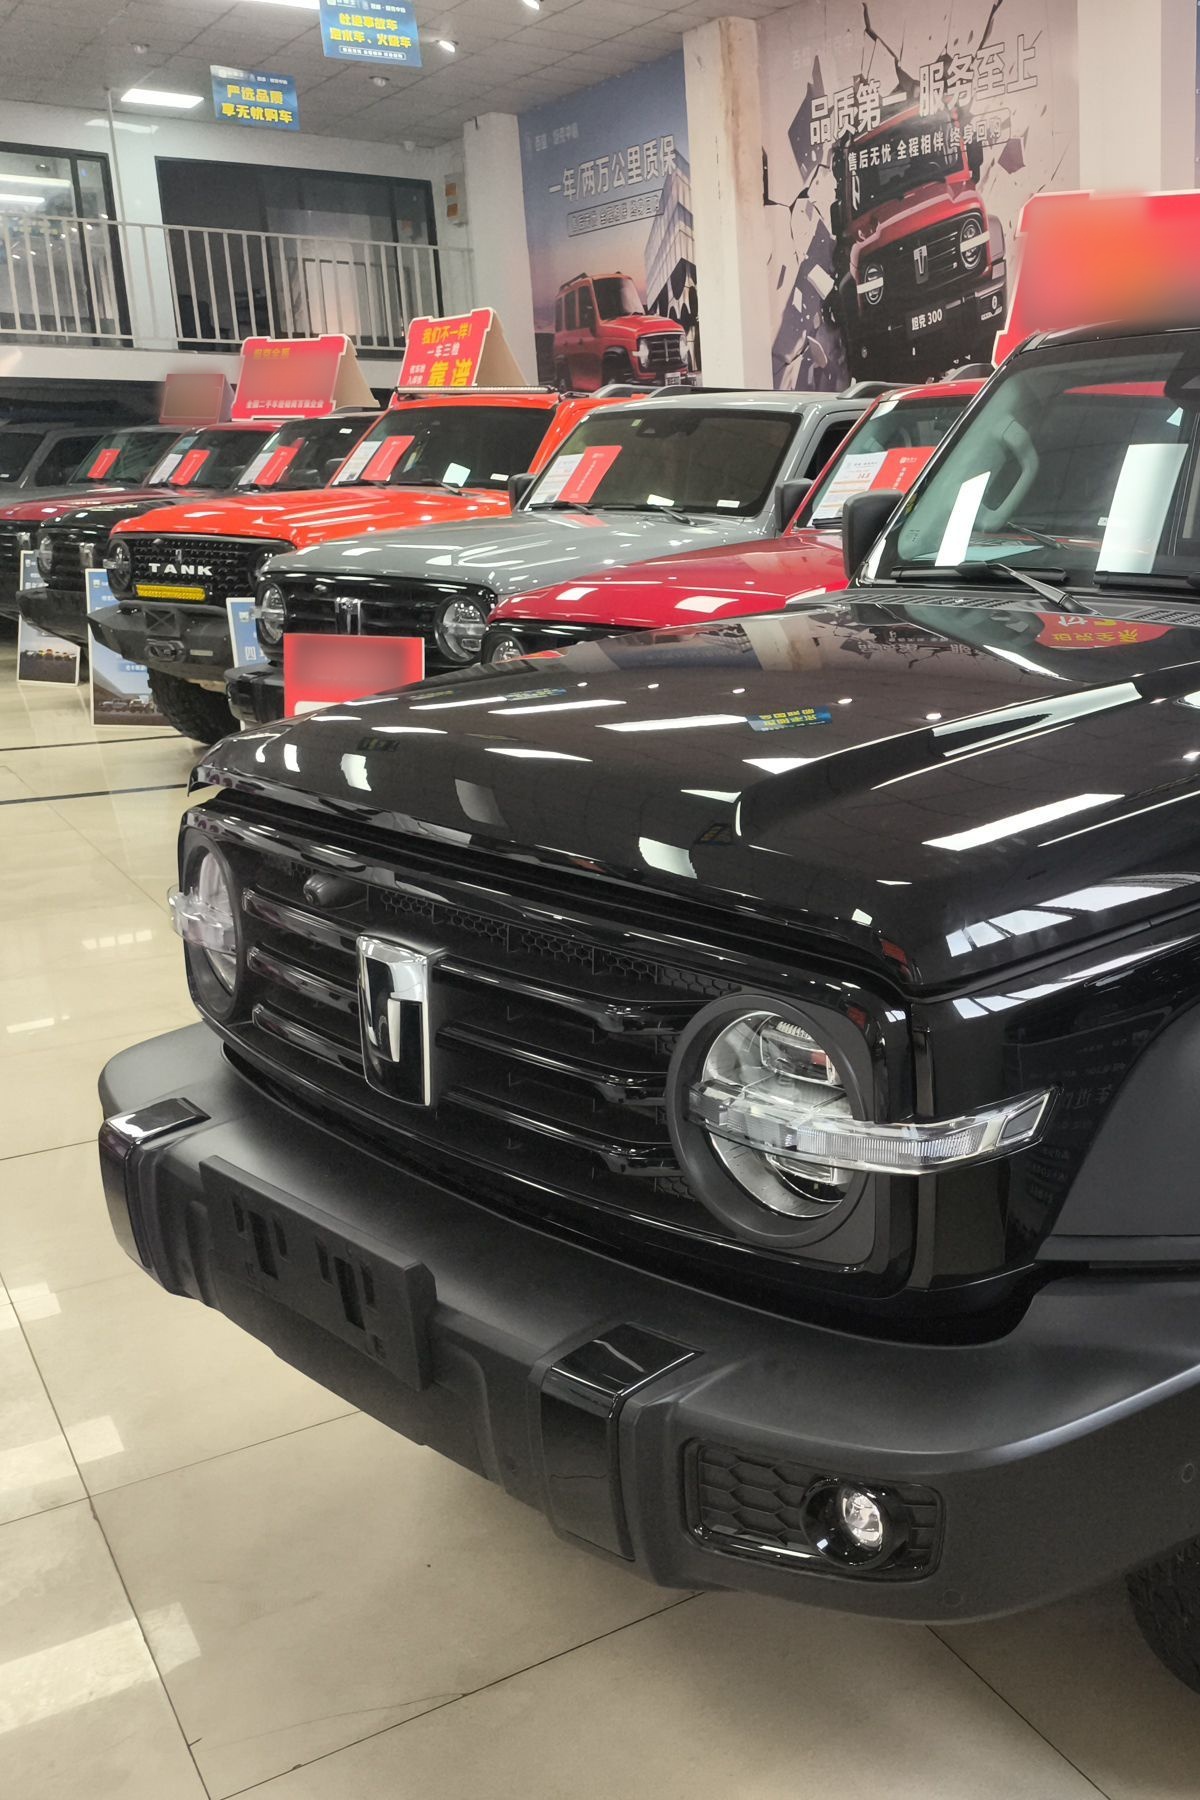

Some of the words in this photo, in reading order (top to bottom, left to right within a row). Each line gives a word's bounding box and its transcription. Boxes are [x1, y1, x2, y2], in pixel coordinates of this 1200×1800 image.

[227, 84, 283, 104] 严选品质
[810, 78, 907, 146] 品质第一
[919, 34, 1038, 118] 服务至上
[221, 102, 293, 123] 享无忧购车
[848, 143, 892, 172] 售后无忧
[897, 134, 945, 161] 全程相伴
[549, 134, 677, 200] 一年/两万公里质保
[911, 308, 943, 331] 坦克300
[148, 562, 213, 576] TANK
